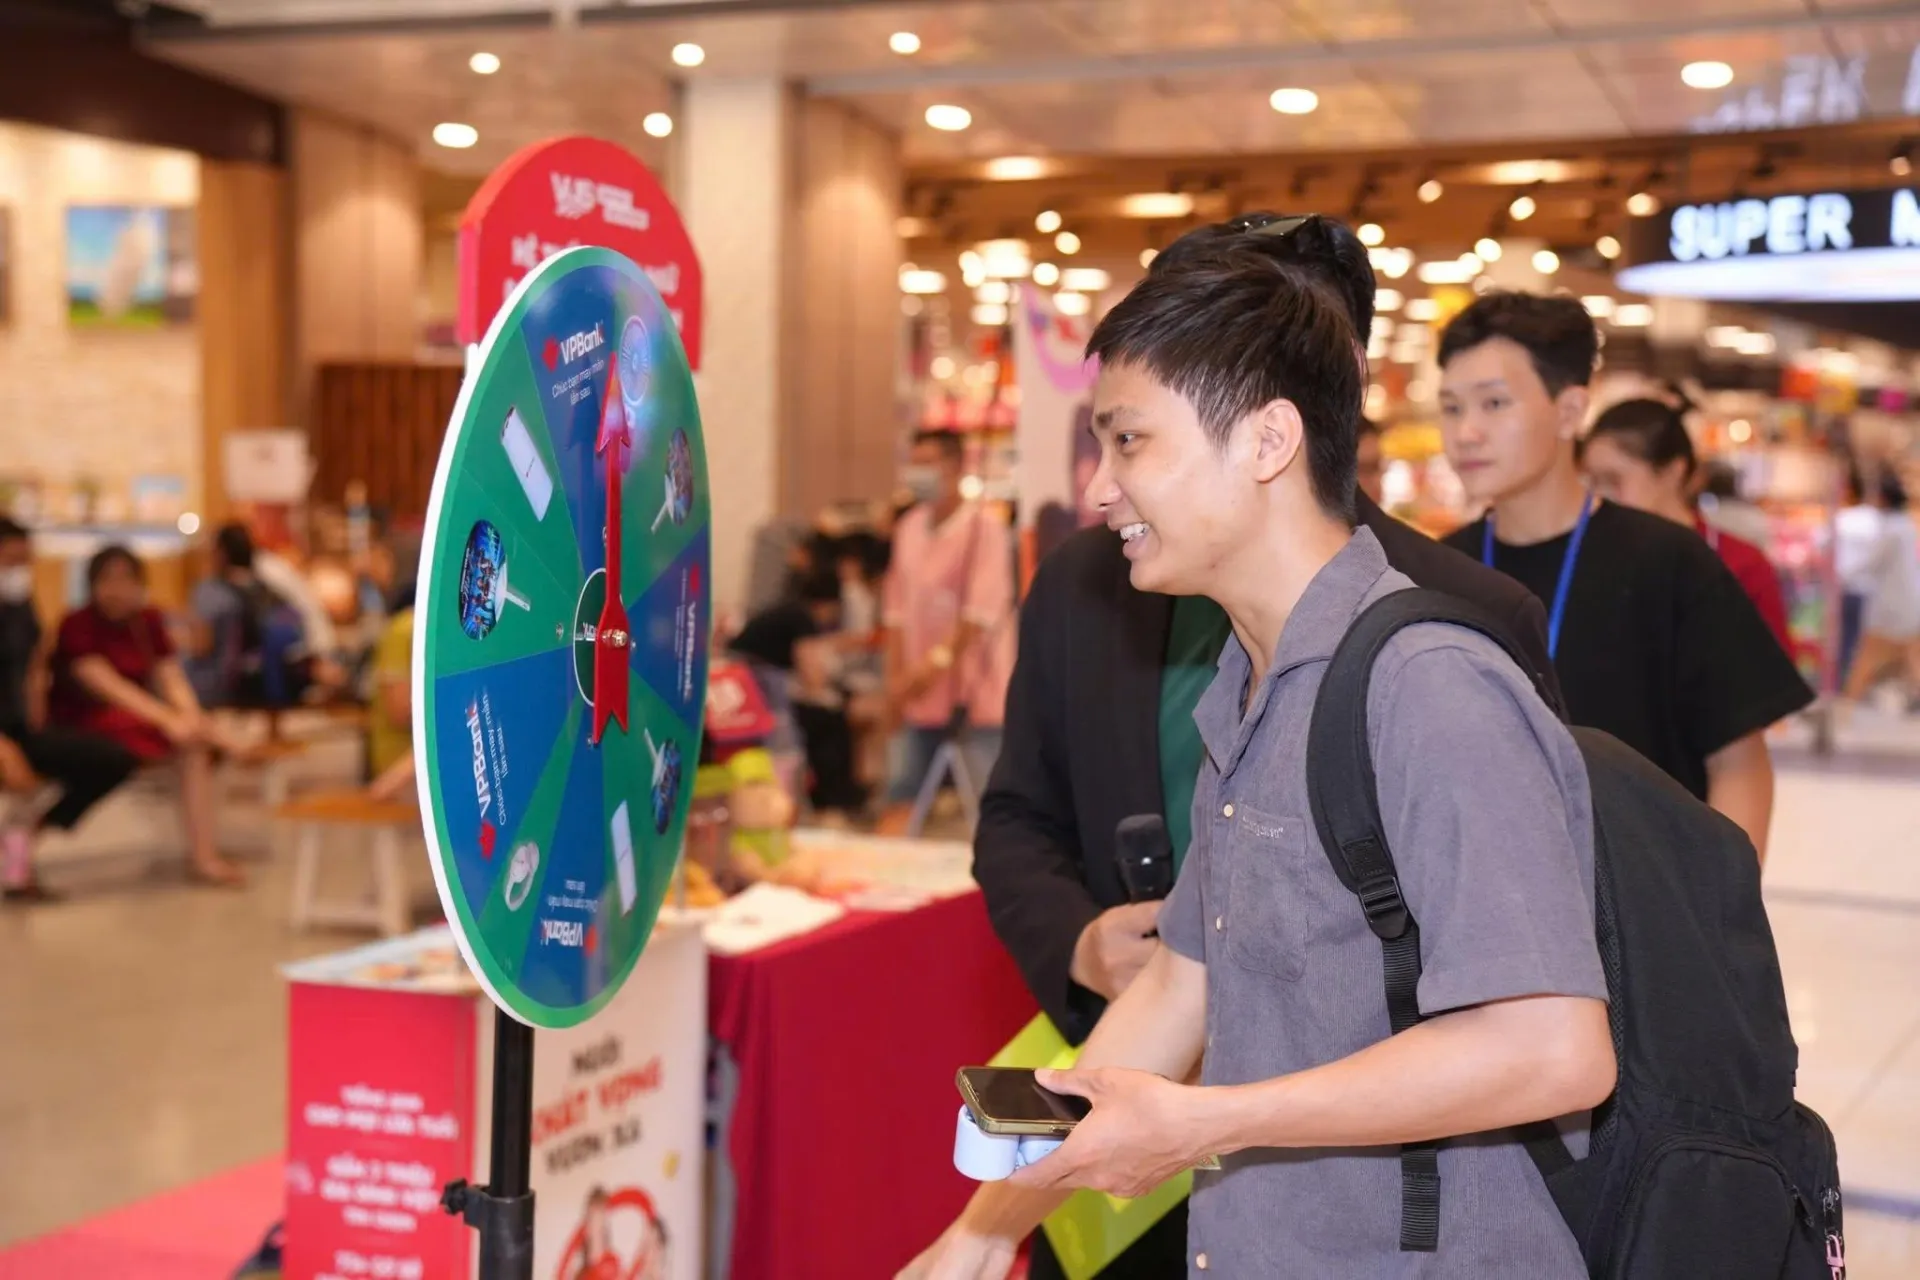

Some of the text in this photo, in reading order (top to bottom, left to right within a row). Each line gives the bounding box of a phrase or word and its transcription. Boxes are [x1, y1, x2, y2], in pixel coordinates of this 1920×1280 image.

[1669, 192, 1853, 261] SUPER
[560, 322, 604, 365] VPBank
[466, 703, 491, 818] VPBank
[481, 695, 507, 826] Chúc bạn may mắn
[497, 727, 509, 778] lần sau
[541, 919, 583, 947] VPBank
